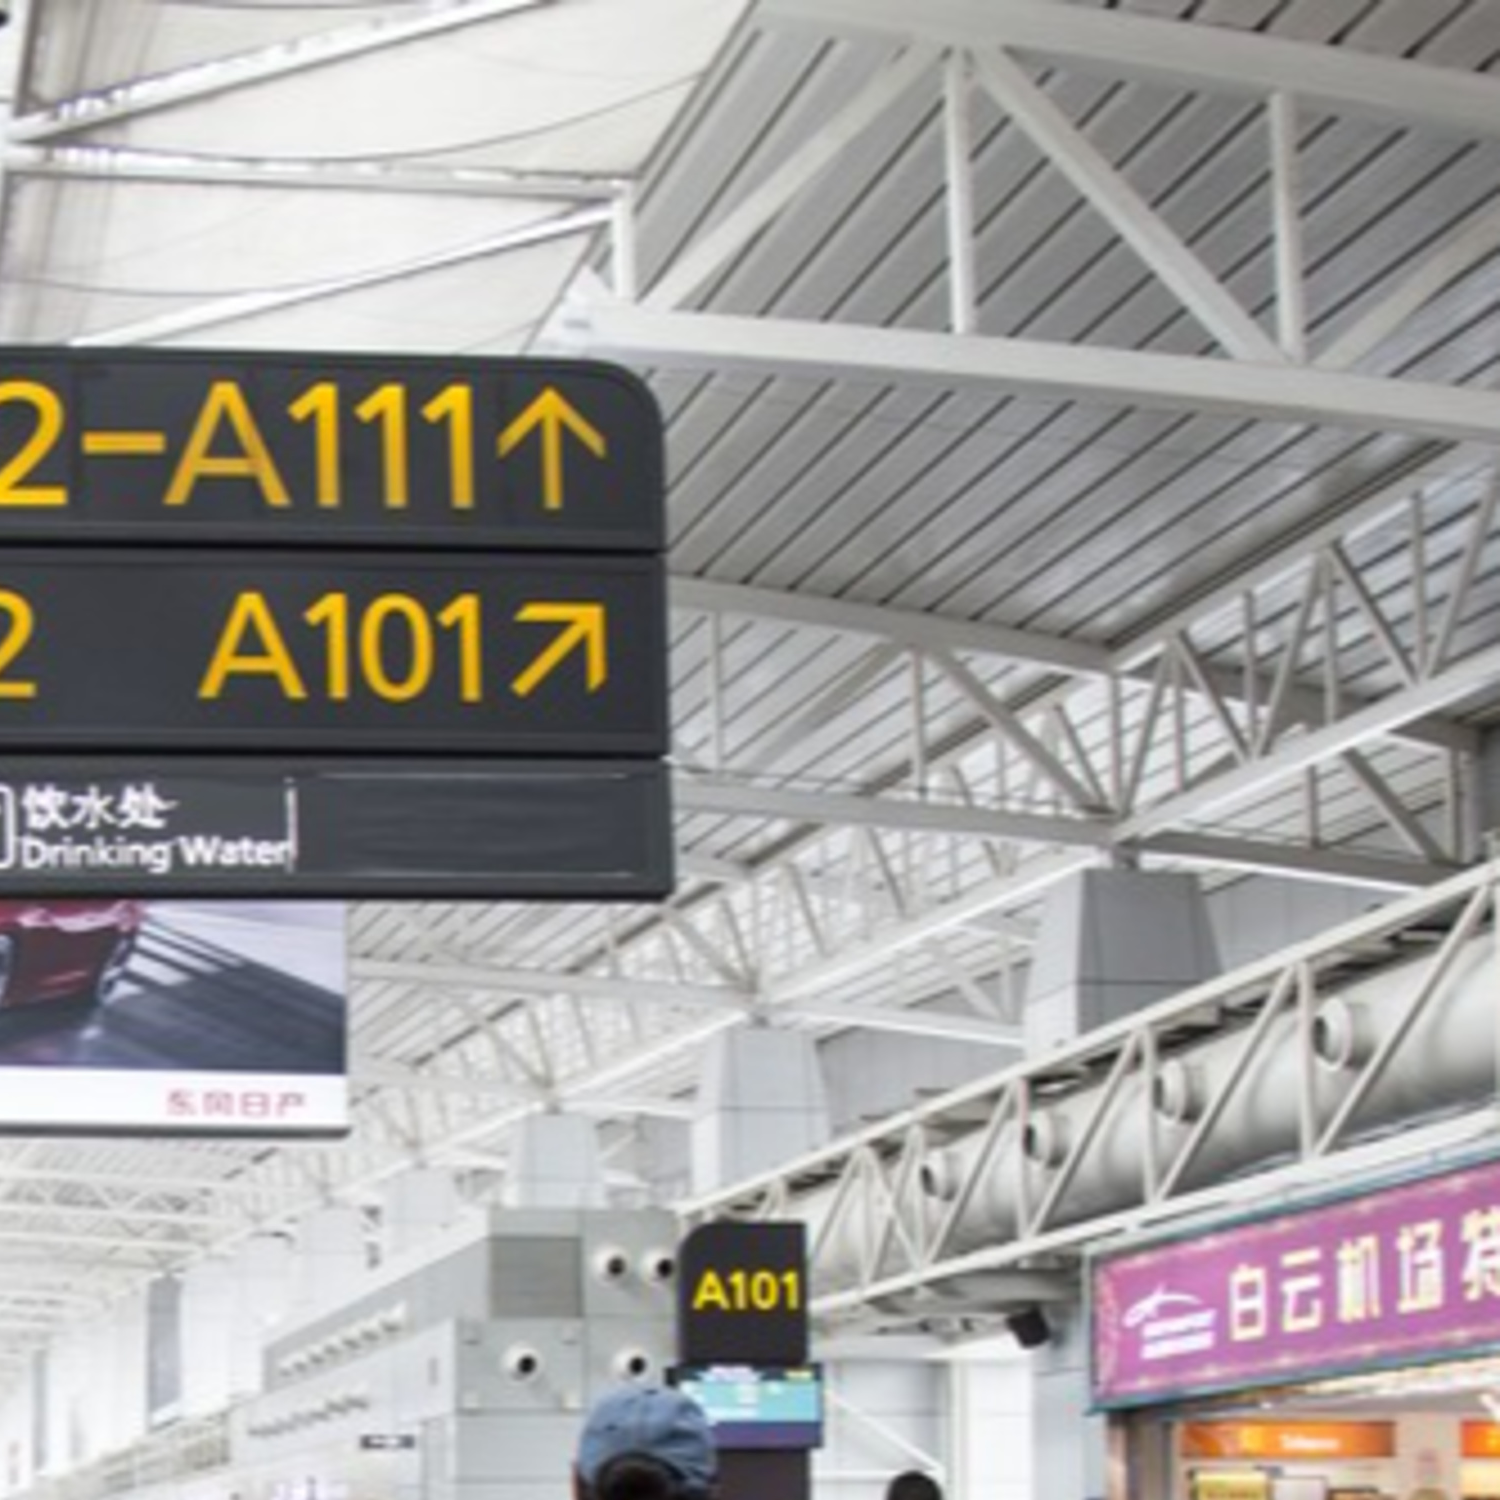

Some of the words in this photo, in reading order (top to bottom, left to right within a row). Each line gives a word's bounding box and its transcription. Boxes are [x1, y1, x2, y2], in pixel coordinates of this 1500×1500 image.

[199, 589, 483, 703] A101
[21, 783, 178, 829] 饮水处
[20, 835, 172, 875] Drinking
[176, 835, 291, 867] Water
[692, 1269, 799, 1311] A101
